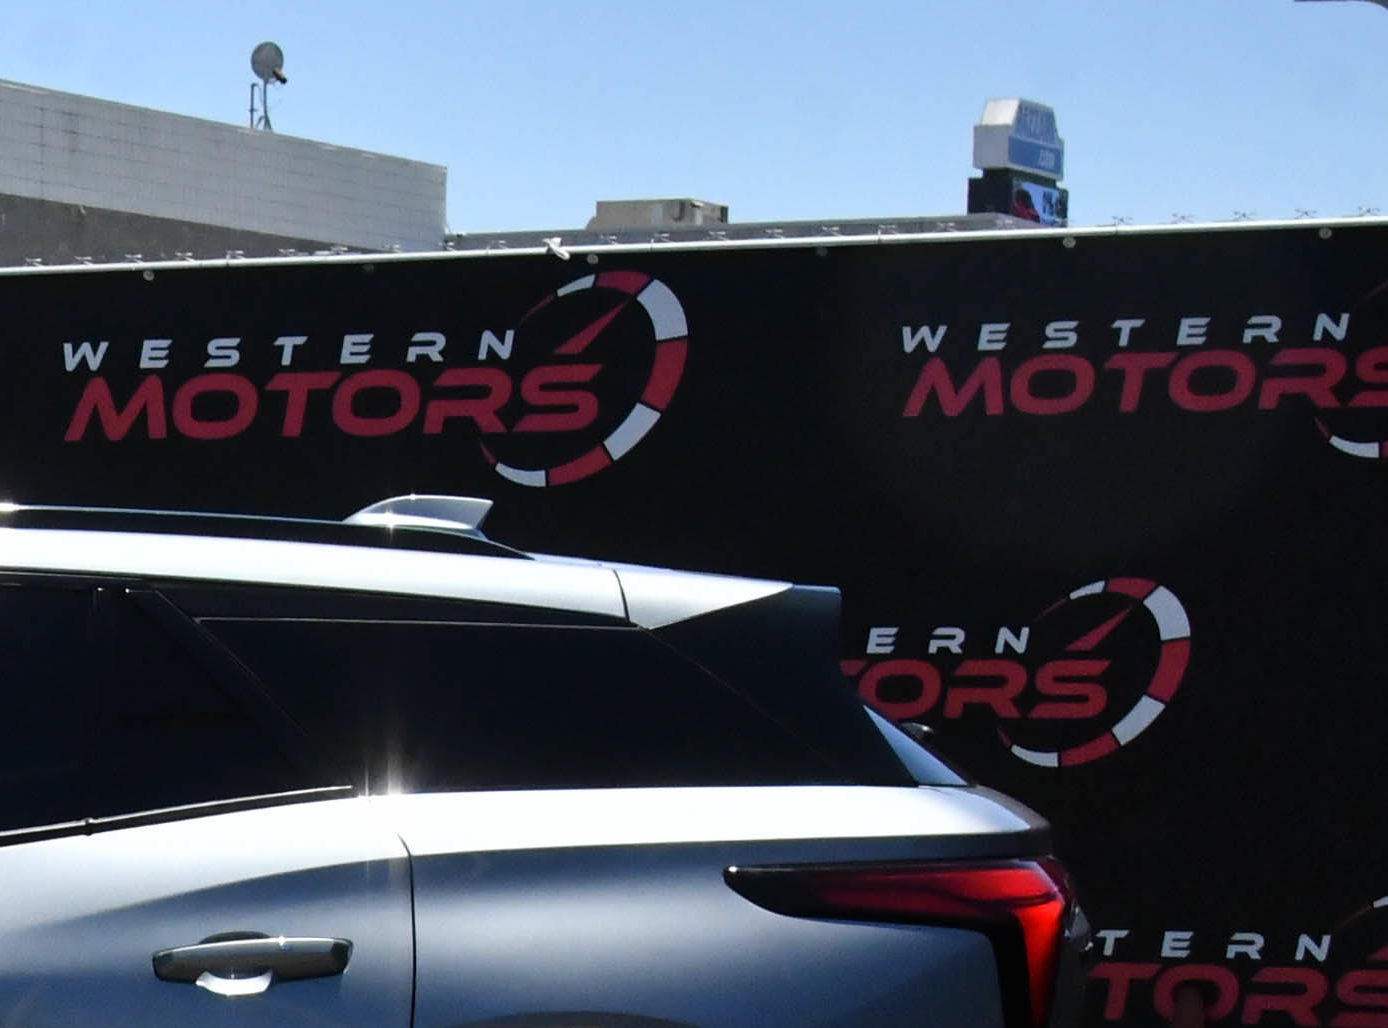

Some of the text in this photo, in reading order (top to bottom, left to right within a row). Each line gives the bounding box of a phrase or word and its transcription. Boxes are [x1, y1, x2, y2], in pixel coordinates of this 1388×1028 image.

[64, 330, 514, 371] WESTERN
[903, 314, 1349, 352] WESTERN
[67, 365, 600, 440] MOTORS
[867, 627, 1029, 653] ERN
[843, 660, 1109, 718] ORS
